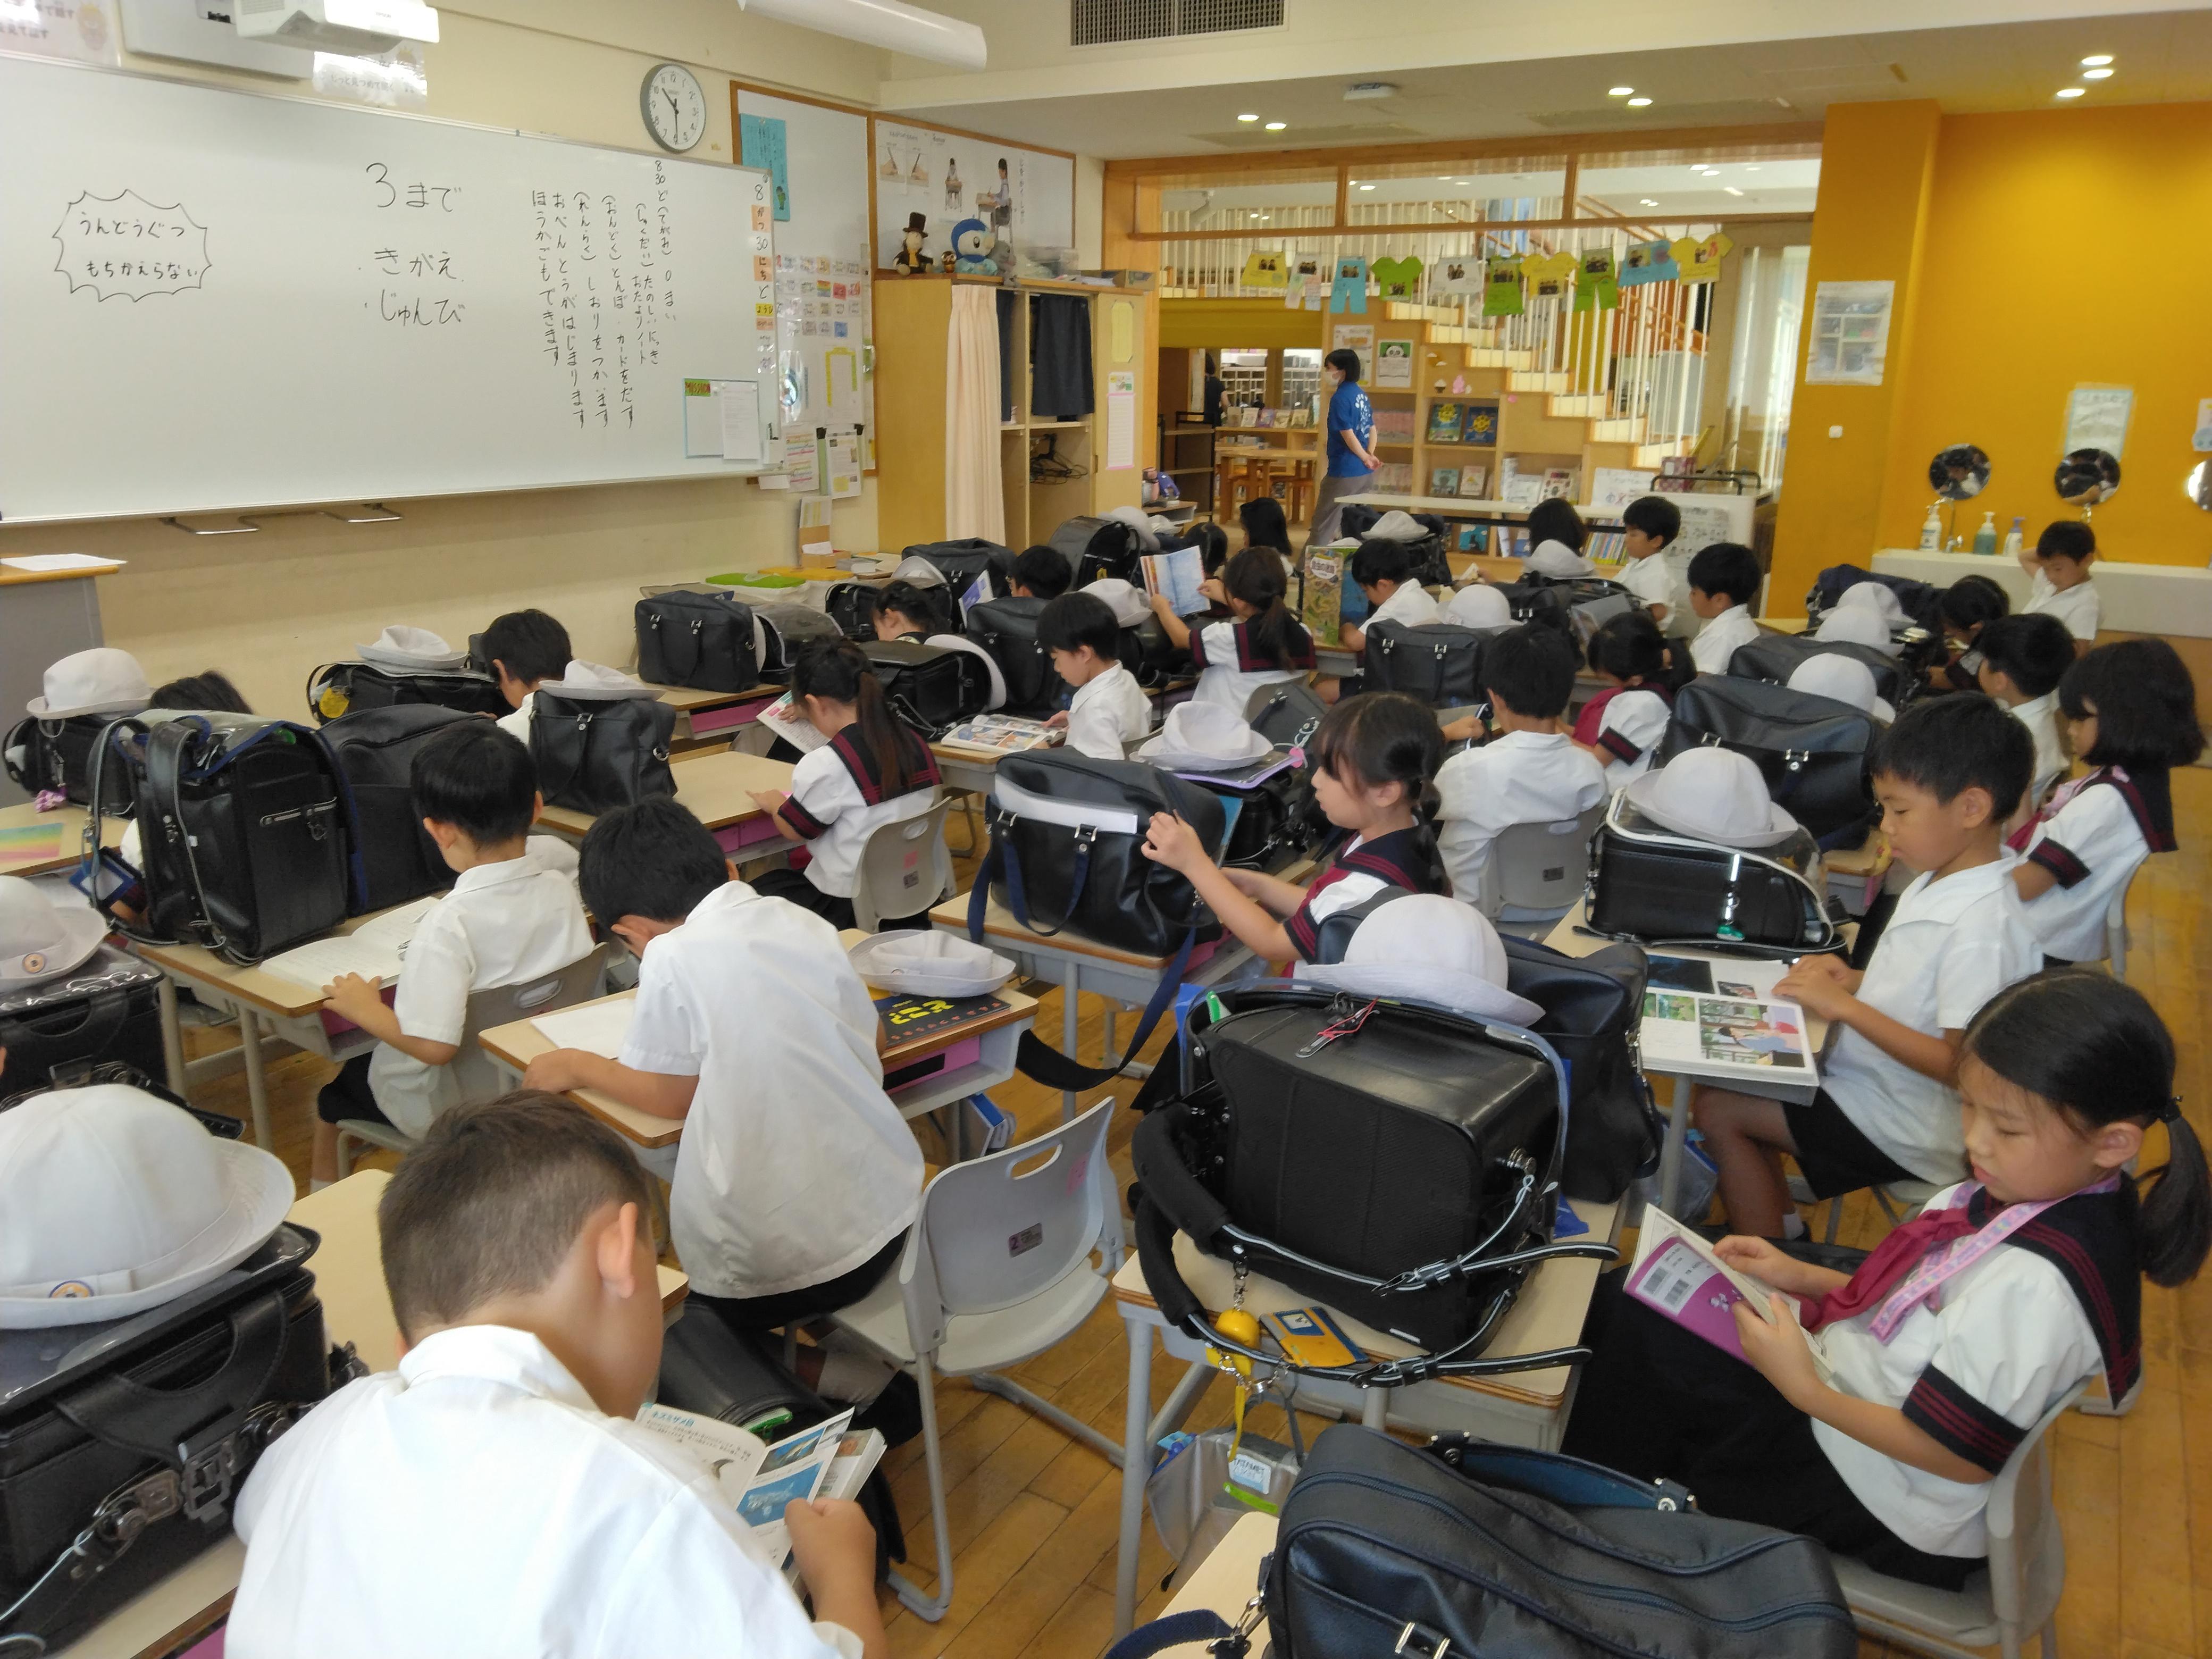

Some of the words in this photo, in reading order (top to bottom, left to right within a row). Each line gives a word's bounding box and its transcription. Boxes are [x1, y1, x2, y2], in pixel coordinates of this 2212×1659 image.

[80, 212, 185, 238] うんどうぐつ
[86, 260, 198, 280] もちかえらない
